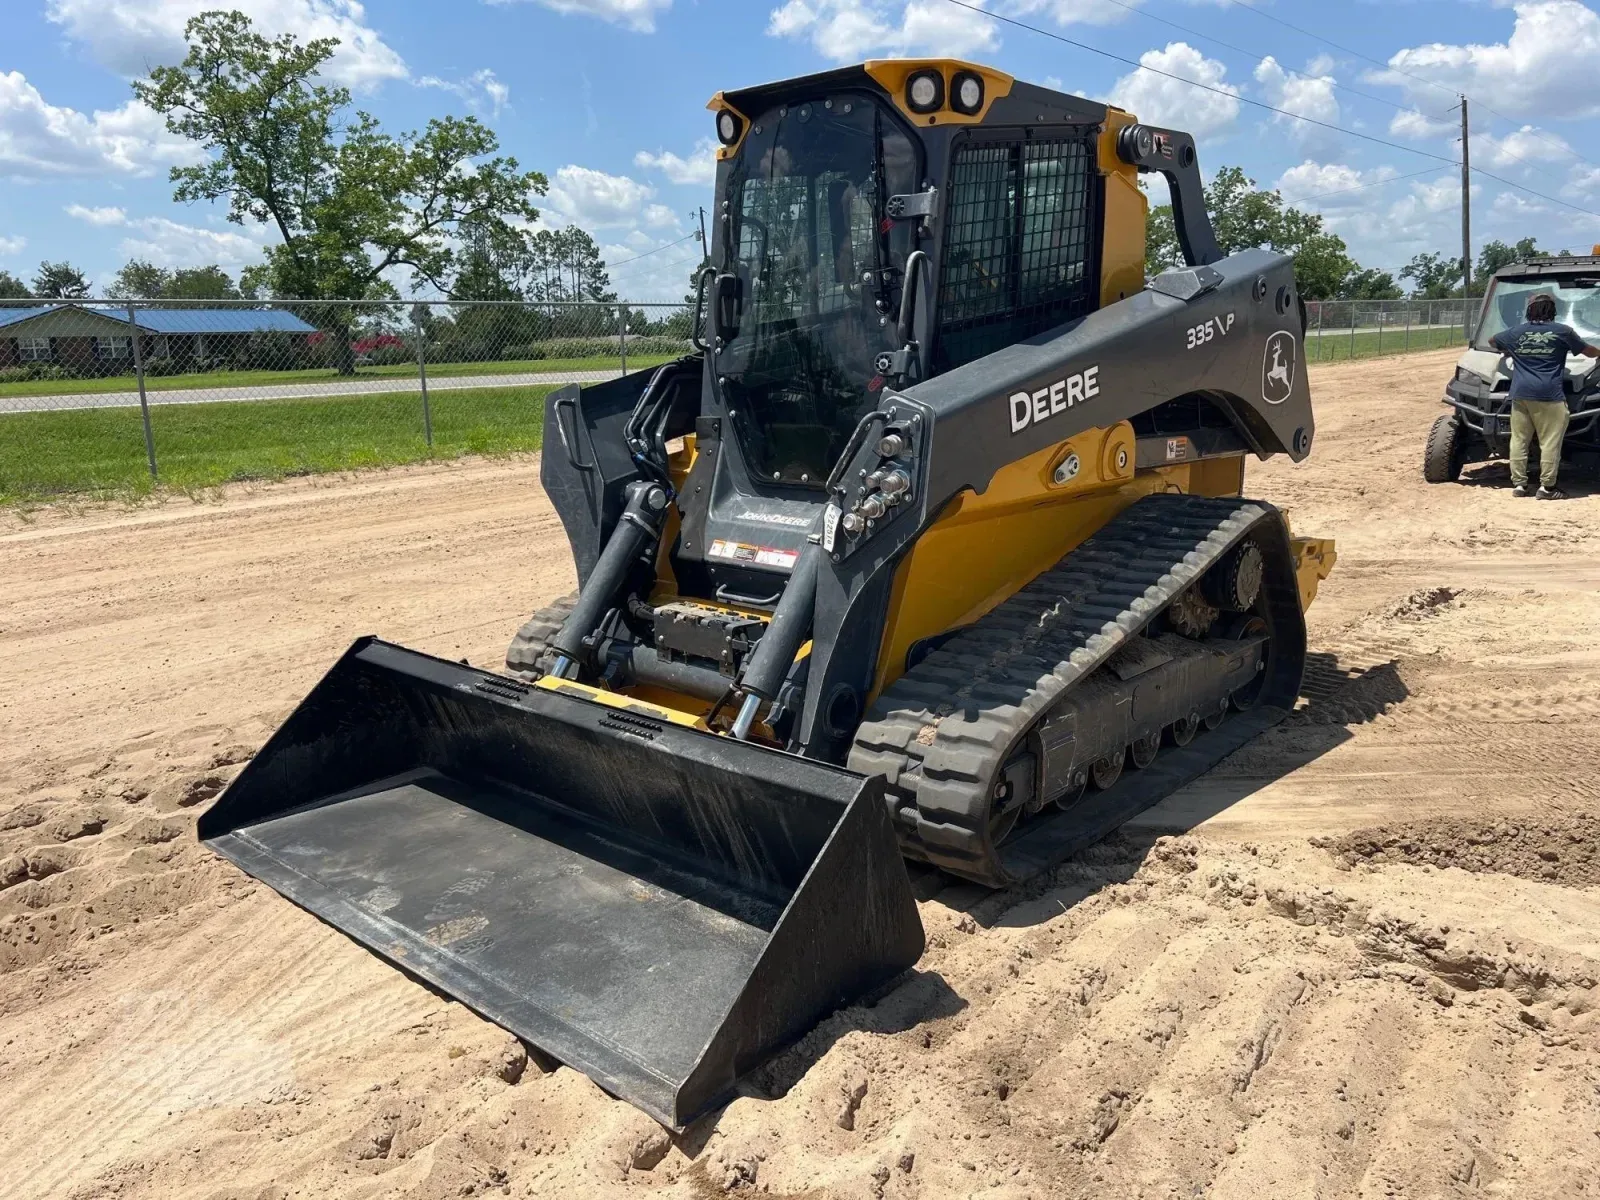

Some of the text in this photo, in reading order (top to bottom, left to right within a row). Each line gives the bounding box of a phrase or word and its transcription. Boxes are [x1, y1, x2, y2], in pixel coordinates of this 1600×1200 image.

[1009, 365, 1099, 433] DEERE
[735, 511, 813, 528] JOHN DEERE
